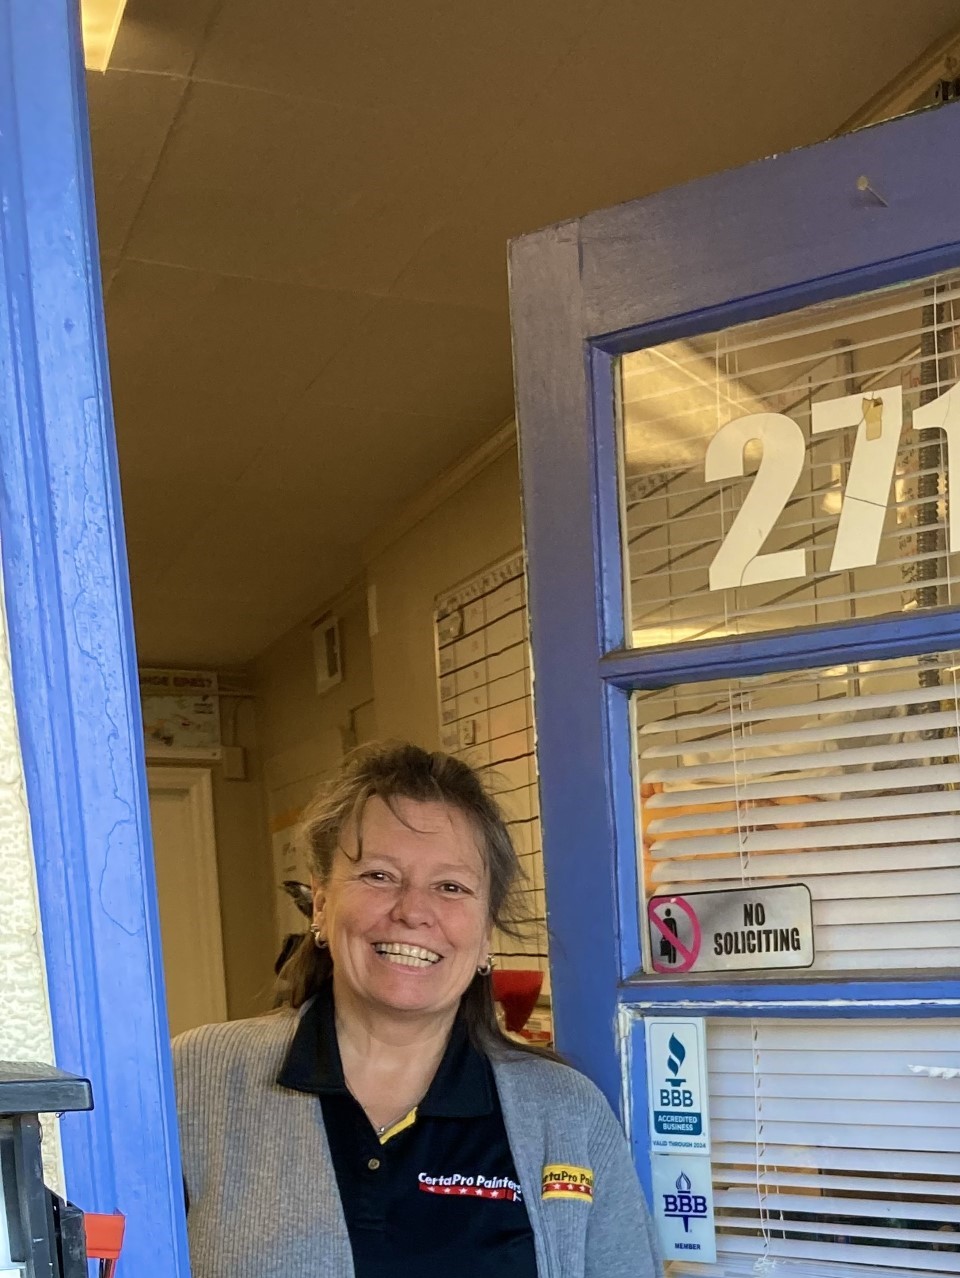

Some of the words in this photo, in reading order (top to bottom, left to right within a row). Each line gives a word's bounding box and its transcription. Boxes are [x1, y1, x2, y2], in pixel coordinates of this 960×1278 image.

[743, 903, 766, 927] NO
[713, 927, 801, 956] SOLICITING
[660, 1088, 694, 1107] BBB
[657, 1115, 698, 1124] ACCREDITED
[662, 1123, 694, 1131] BUSINESS
[418, 1172, 474, 1187] CertaPro
[662, 1194, 708, 1213] BBB
[674, 1242, 701, 1250] MEMBER
